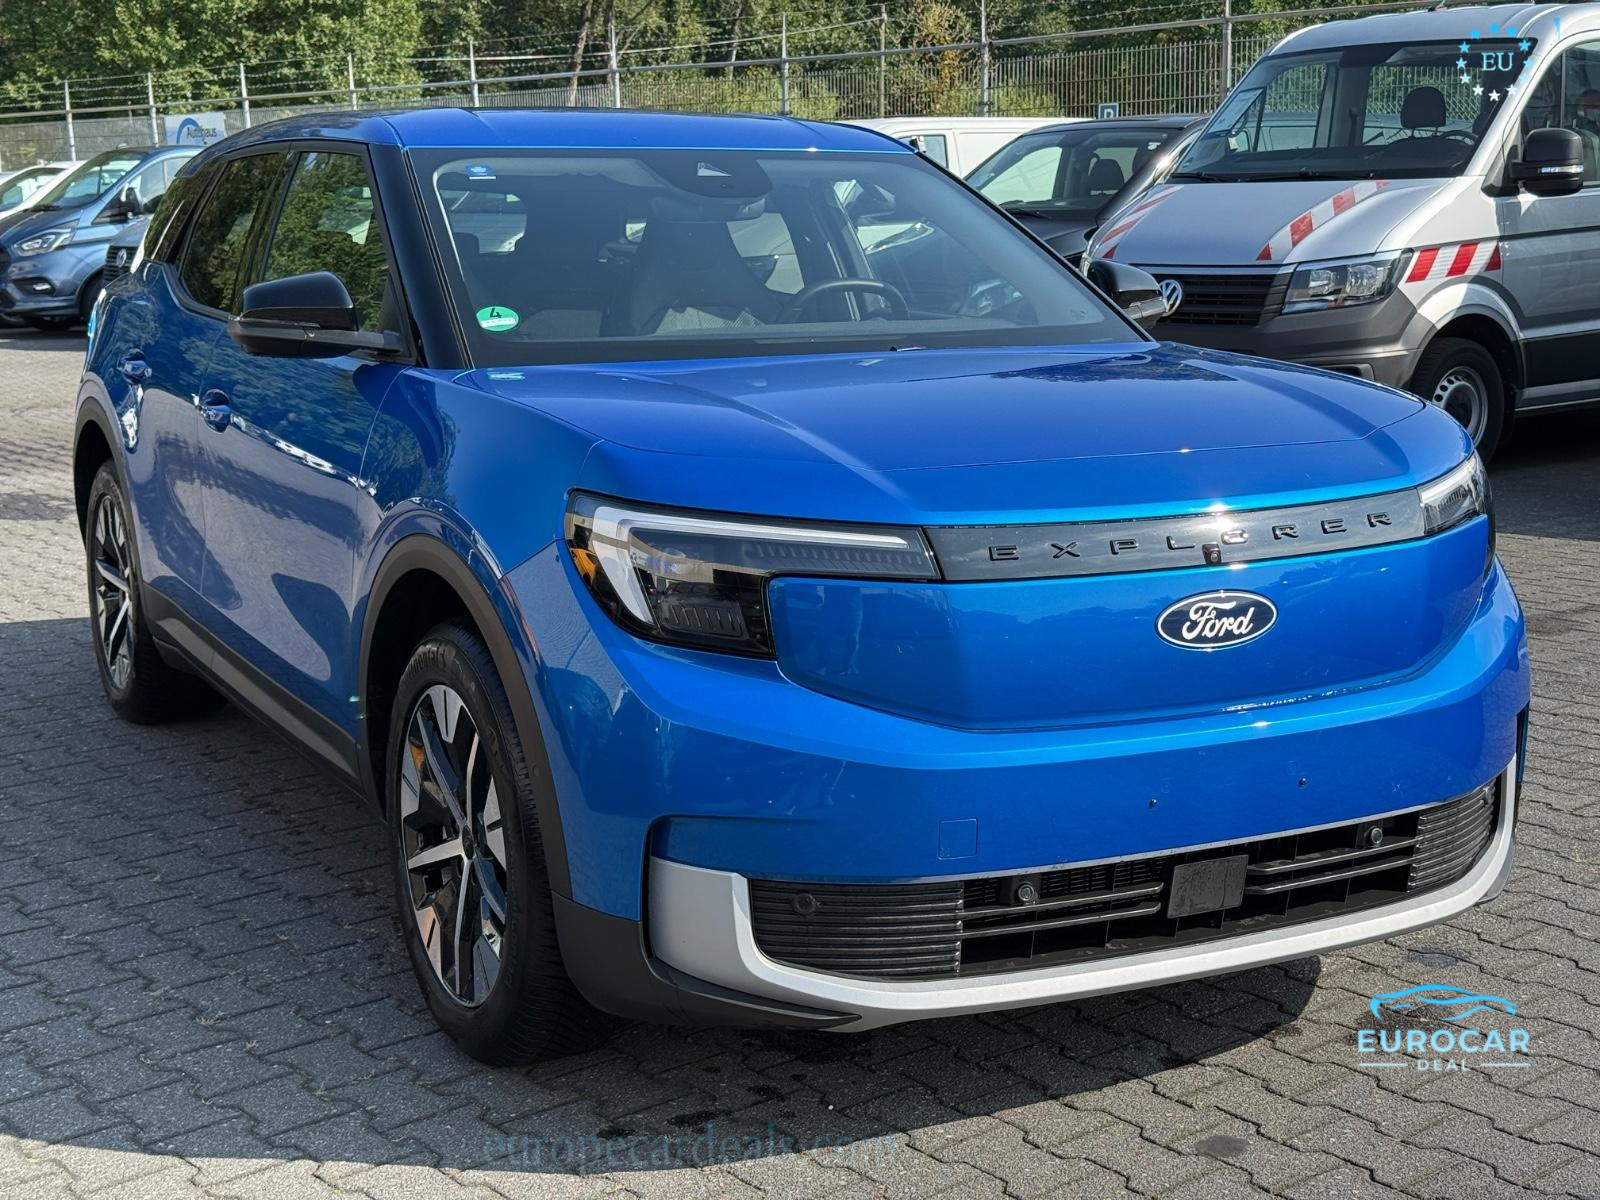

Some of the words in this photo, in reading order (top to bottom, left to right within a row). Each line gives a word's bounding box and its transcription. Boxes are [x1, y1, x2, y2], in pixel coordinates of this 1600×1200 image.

[489, 307, 502, 319] 4
[988, 512, 1393, 561] EXPLORER
[1181, 600, 1254, 641] Ford
